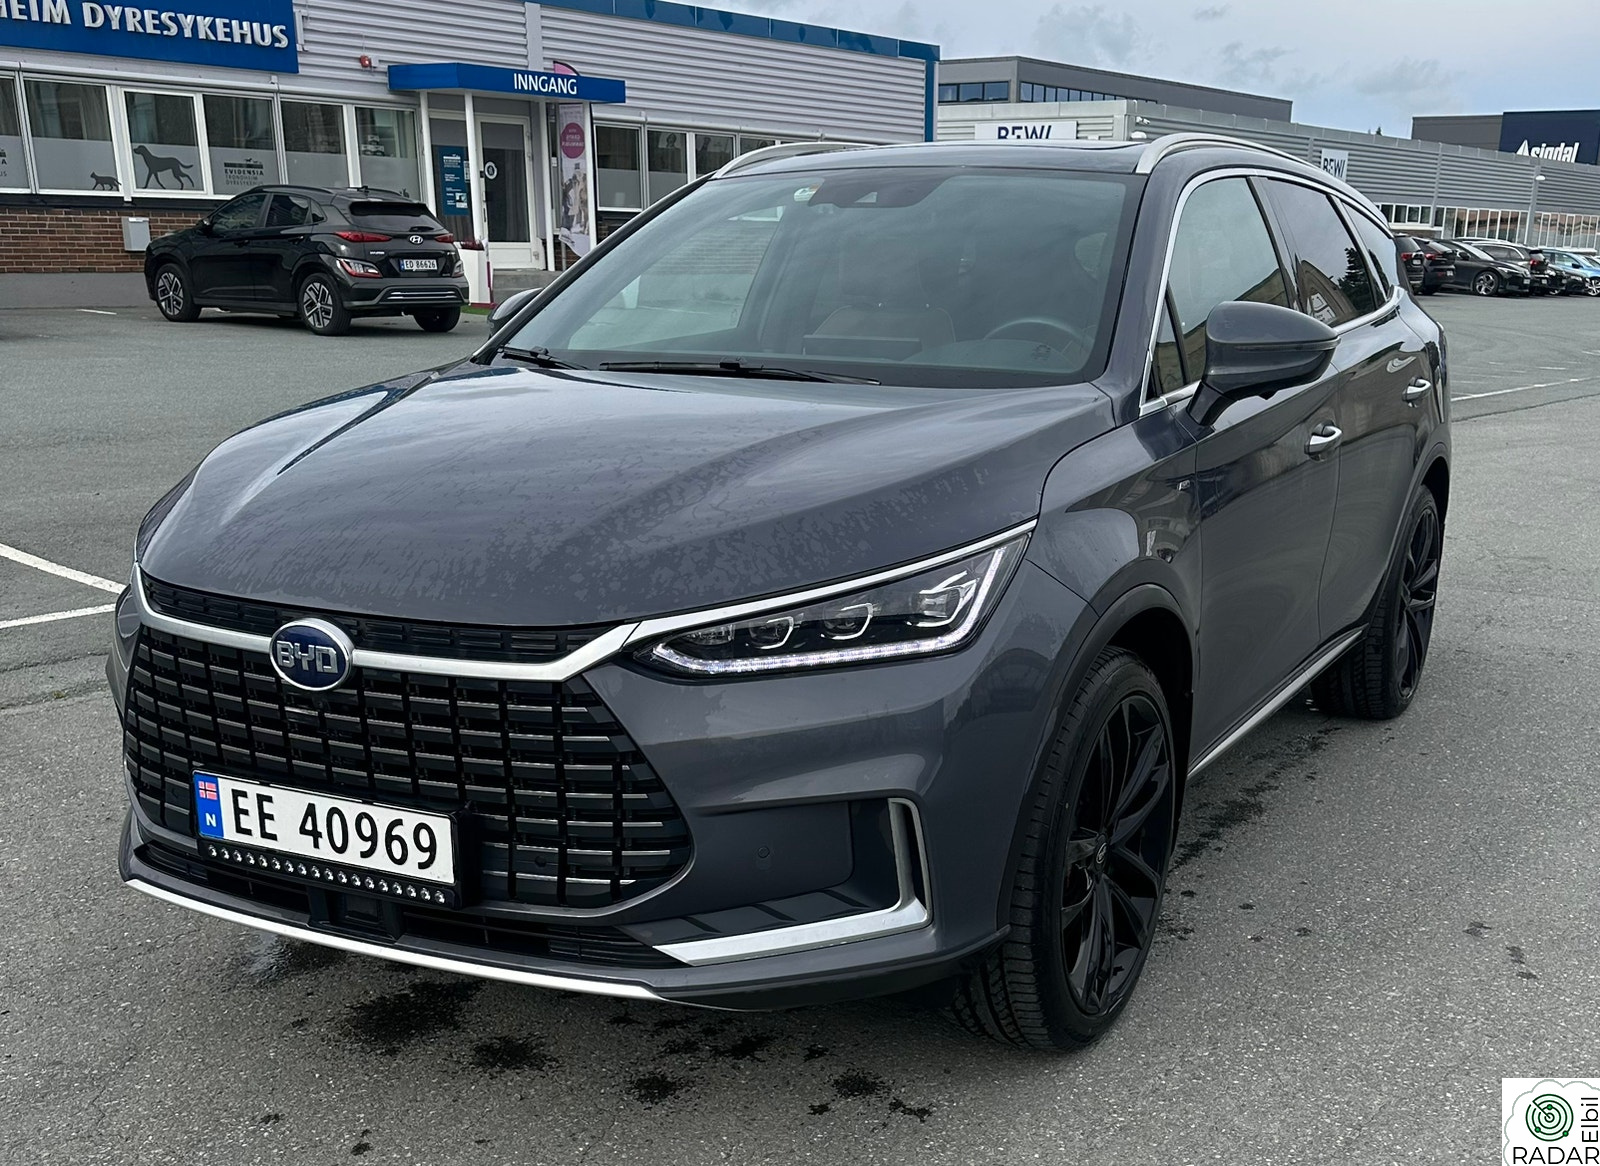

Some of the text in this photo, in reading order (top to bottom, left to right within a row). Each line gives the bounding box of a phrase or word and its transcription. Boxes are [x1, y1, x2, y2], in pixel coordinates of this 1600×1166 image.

[82, 2, 289, 48] DYRESYKEHUS
[513, 73, 578, 95] INNGANG
[405, 260, 414, 269] ED
[276, 640, 339, 674] BYD
[205, 812, 218, 828] N
[231, 788, 437, 870] EE 40969
